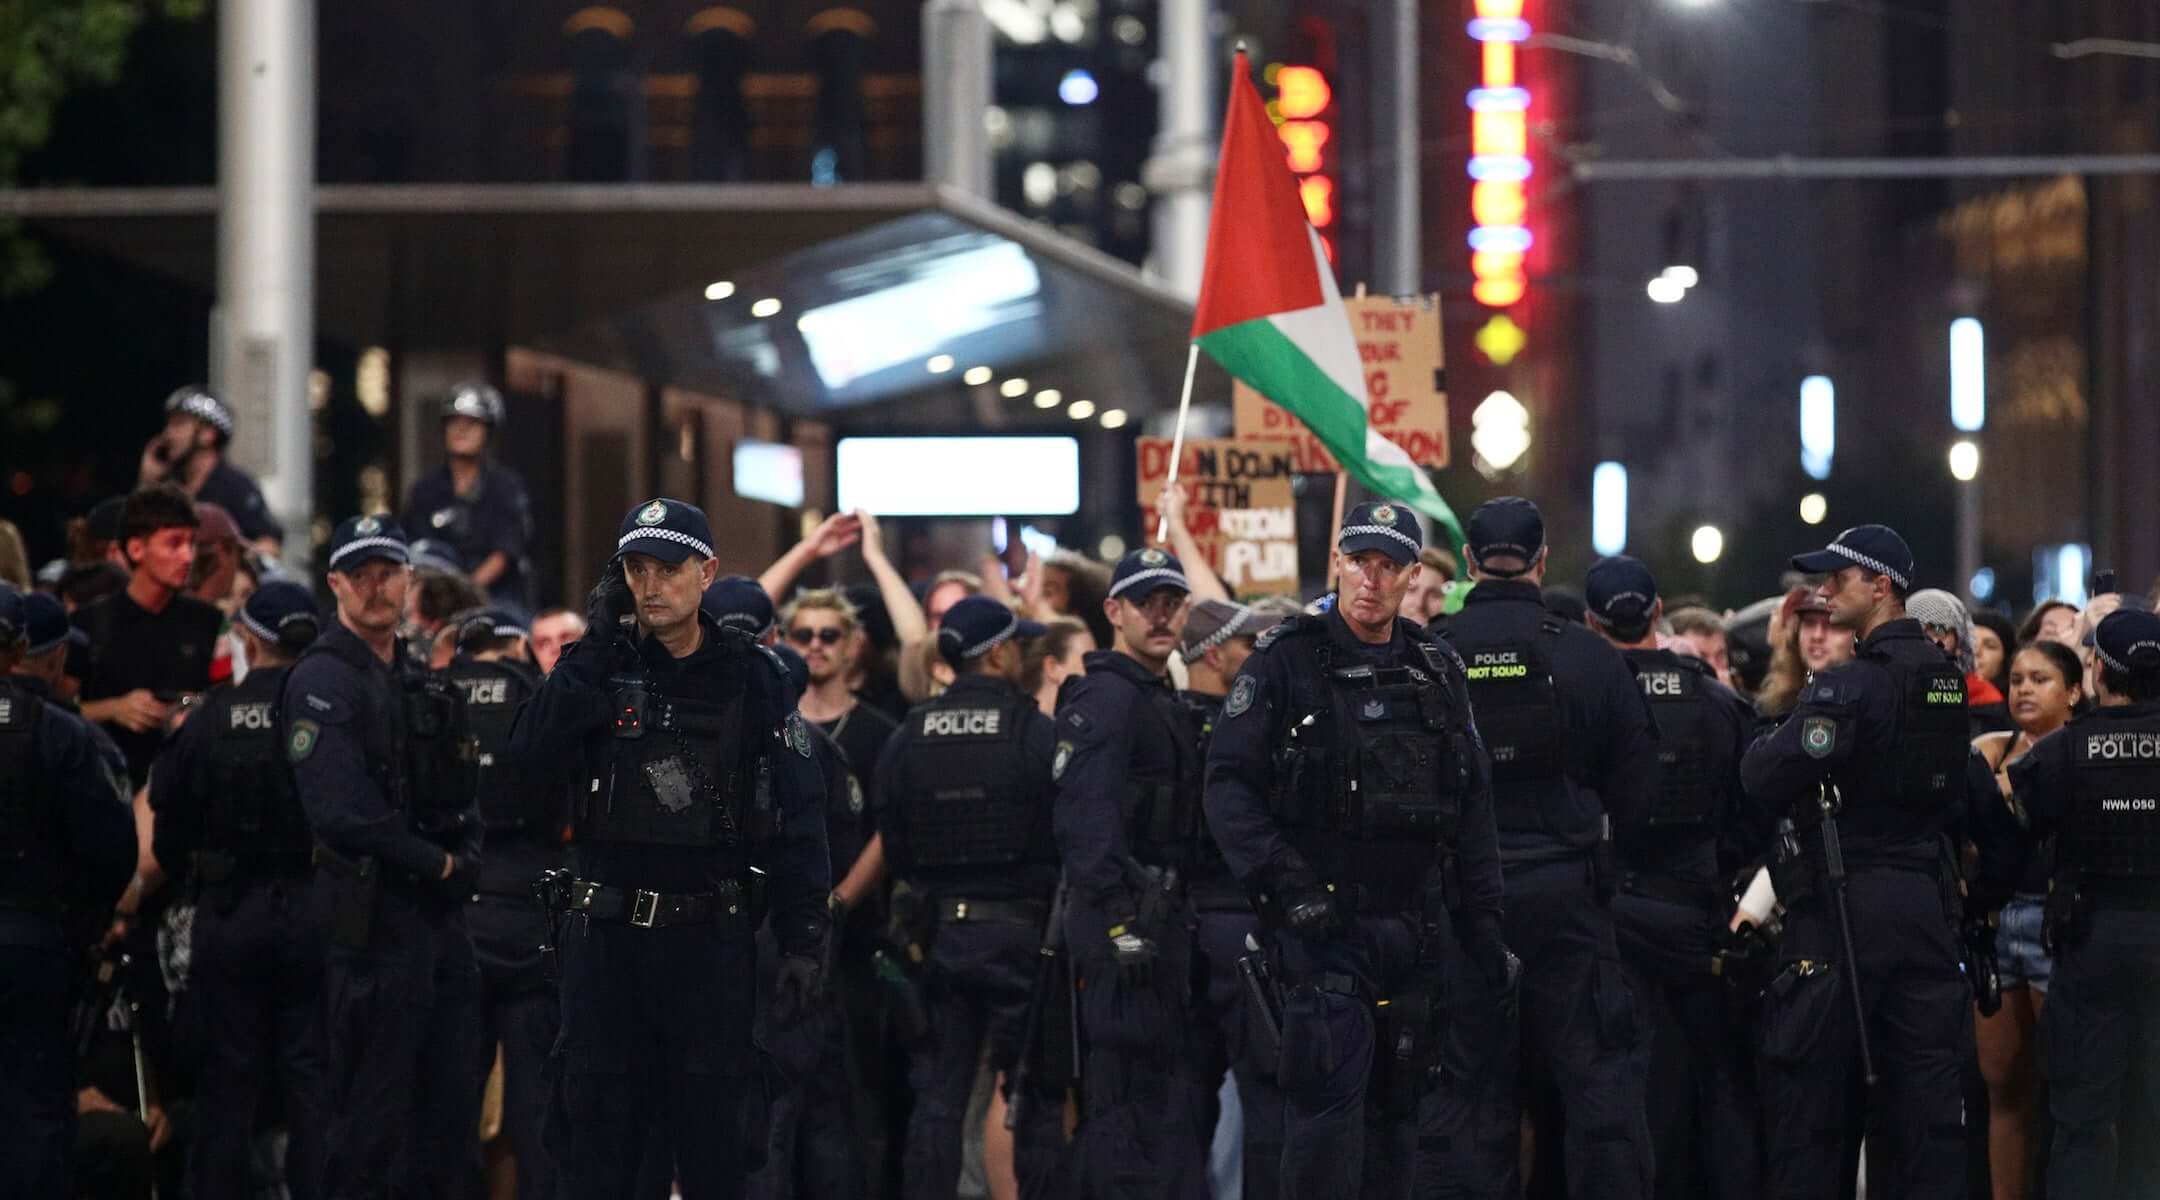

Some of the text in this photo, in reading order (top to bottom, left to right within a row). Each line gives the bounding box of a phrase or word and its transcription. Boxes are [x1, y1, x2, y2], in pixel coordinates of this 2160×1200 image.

[1475, 652, 1518, 665] POLICE
[1467, 665, 1527, 679] RIOT SQUAD
[1644, 679, 1682, 695] ICE
[1932, 678, 1959, 690] POLICE
[468, 684, 506, 704] ICE
[231, 709, 272, 729] POL
[923, 712, 999, 736] POLICE
[2109, 732, 2137, 741] SOUTH
[2102, 799, 2130, 811] NWM
